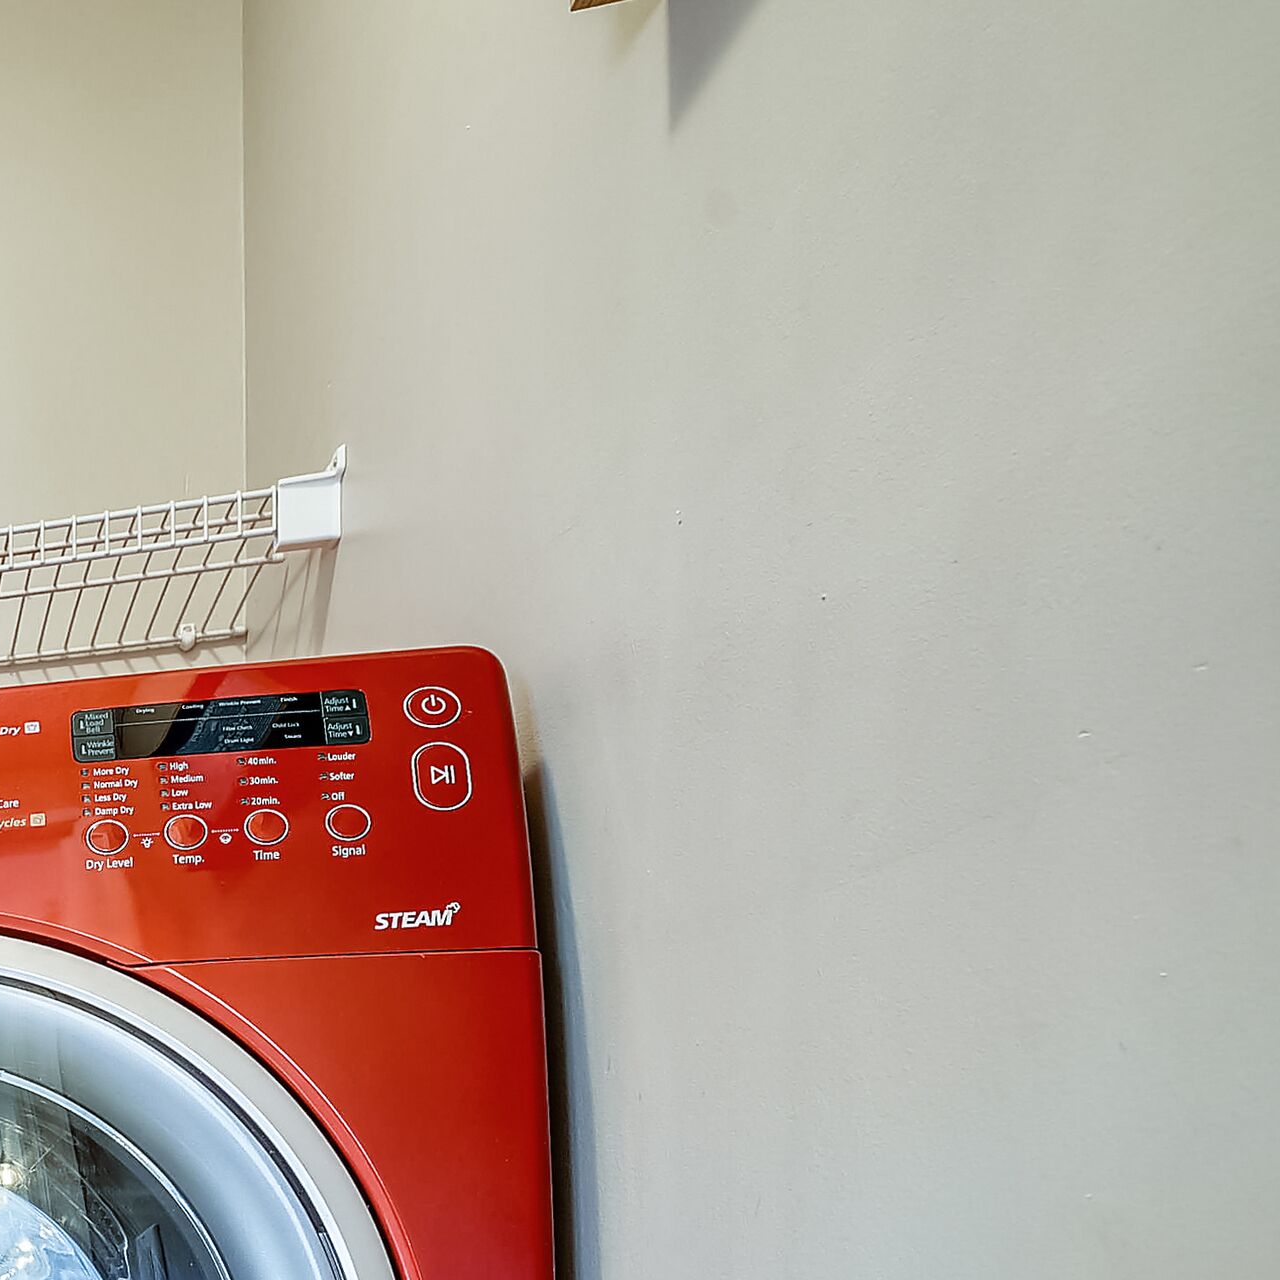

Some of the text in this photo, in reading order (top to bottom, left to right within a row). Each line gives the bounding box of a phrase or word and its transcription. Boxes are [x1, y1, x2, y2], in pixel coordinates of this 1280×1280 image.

[324, 697, 349, 706] Adjust
[84, 712, 109, 720] Mixed
[0, 725, 21, 736] Dry
[327, 722, 353, 731] Adjust
[328, 730, 347, 738] Time
[87, 739, 115, 748] Wrinkle
[327, 752, 356, 761] Louder
[169, 762, 189, 771] High
[93, 767, 130, 776] More Dry
[171, 774, 204, 783] Medium
[329, 772, 355, 781] Softer
[93, 779, 138, 789] Normal Dry
[113, 793, 127, 802] Dry
[171, 789, 189, 797] Low
[331, 792, 345, 800] Off
[195, 801, 212, 809] Low
[95, 806, 134, 816] Damp Dry
[253, 850, 280, 860] Time
[332, 844, 366, 858] Signal
[85, 857, 133, 871] Dry Level
[172, 854, 205, 865] Temp.
[374, 910, 453, 930] STEAM
